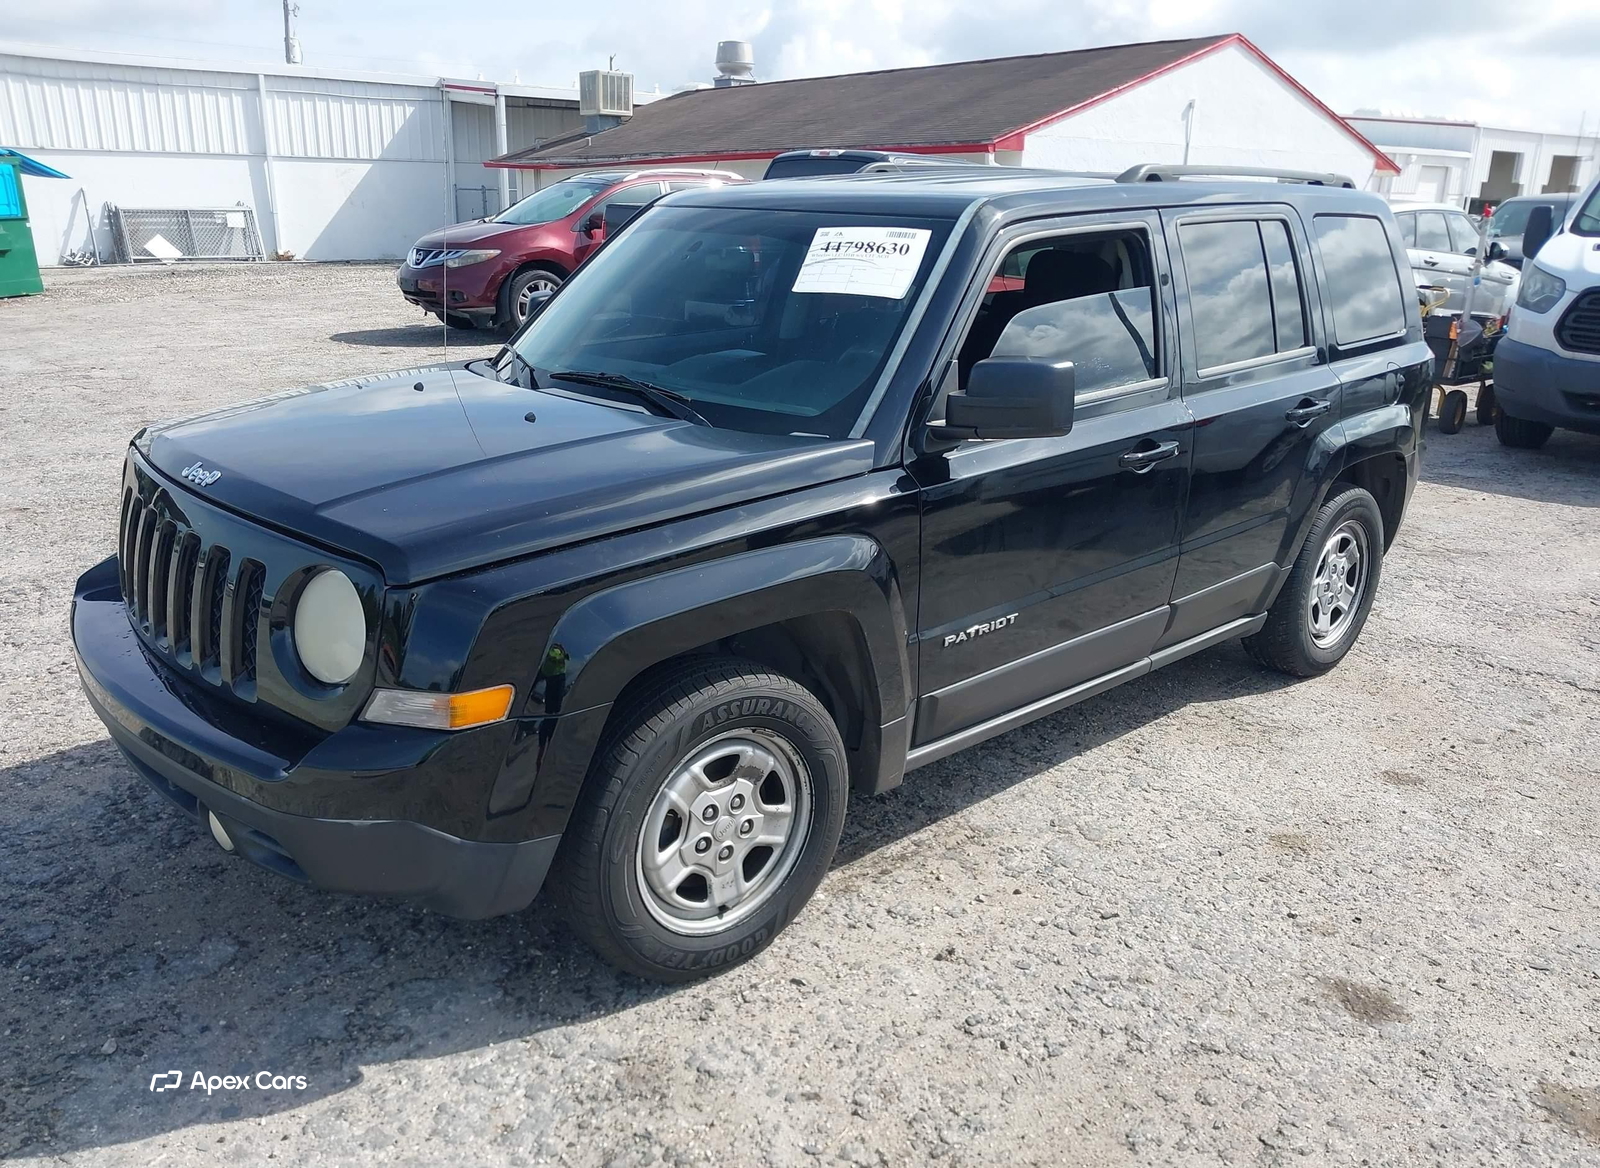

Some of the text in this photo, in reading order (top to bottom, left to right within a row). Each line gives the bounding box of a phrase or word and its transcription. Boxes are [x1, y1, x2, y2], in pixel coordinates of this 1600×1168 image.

[820, 241, 910, 256] 44798630
[181, 461, 222, 487] Jeep
[944, 612, 1019, 647] PATRIOT
[701, 698, 817, 734] ASSURANCE
